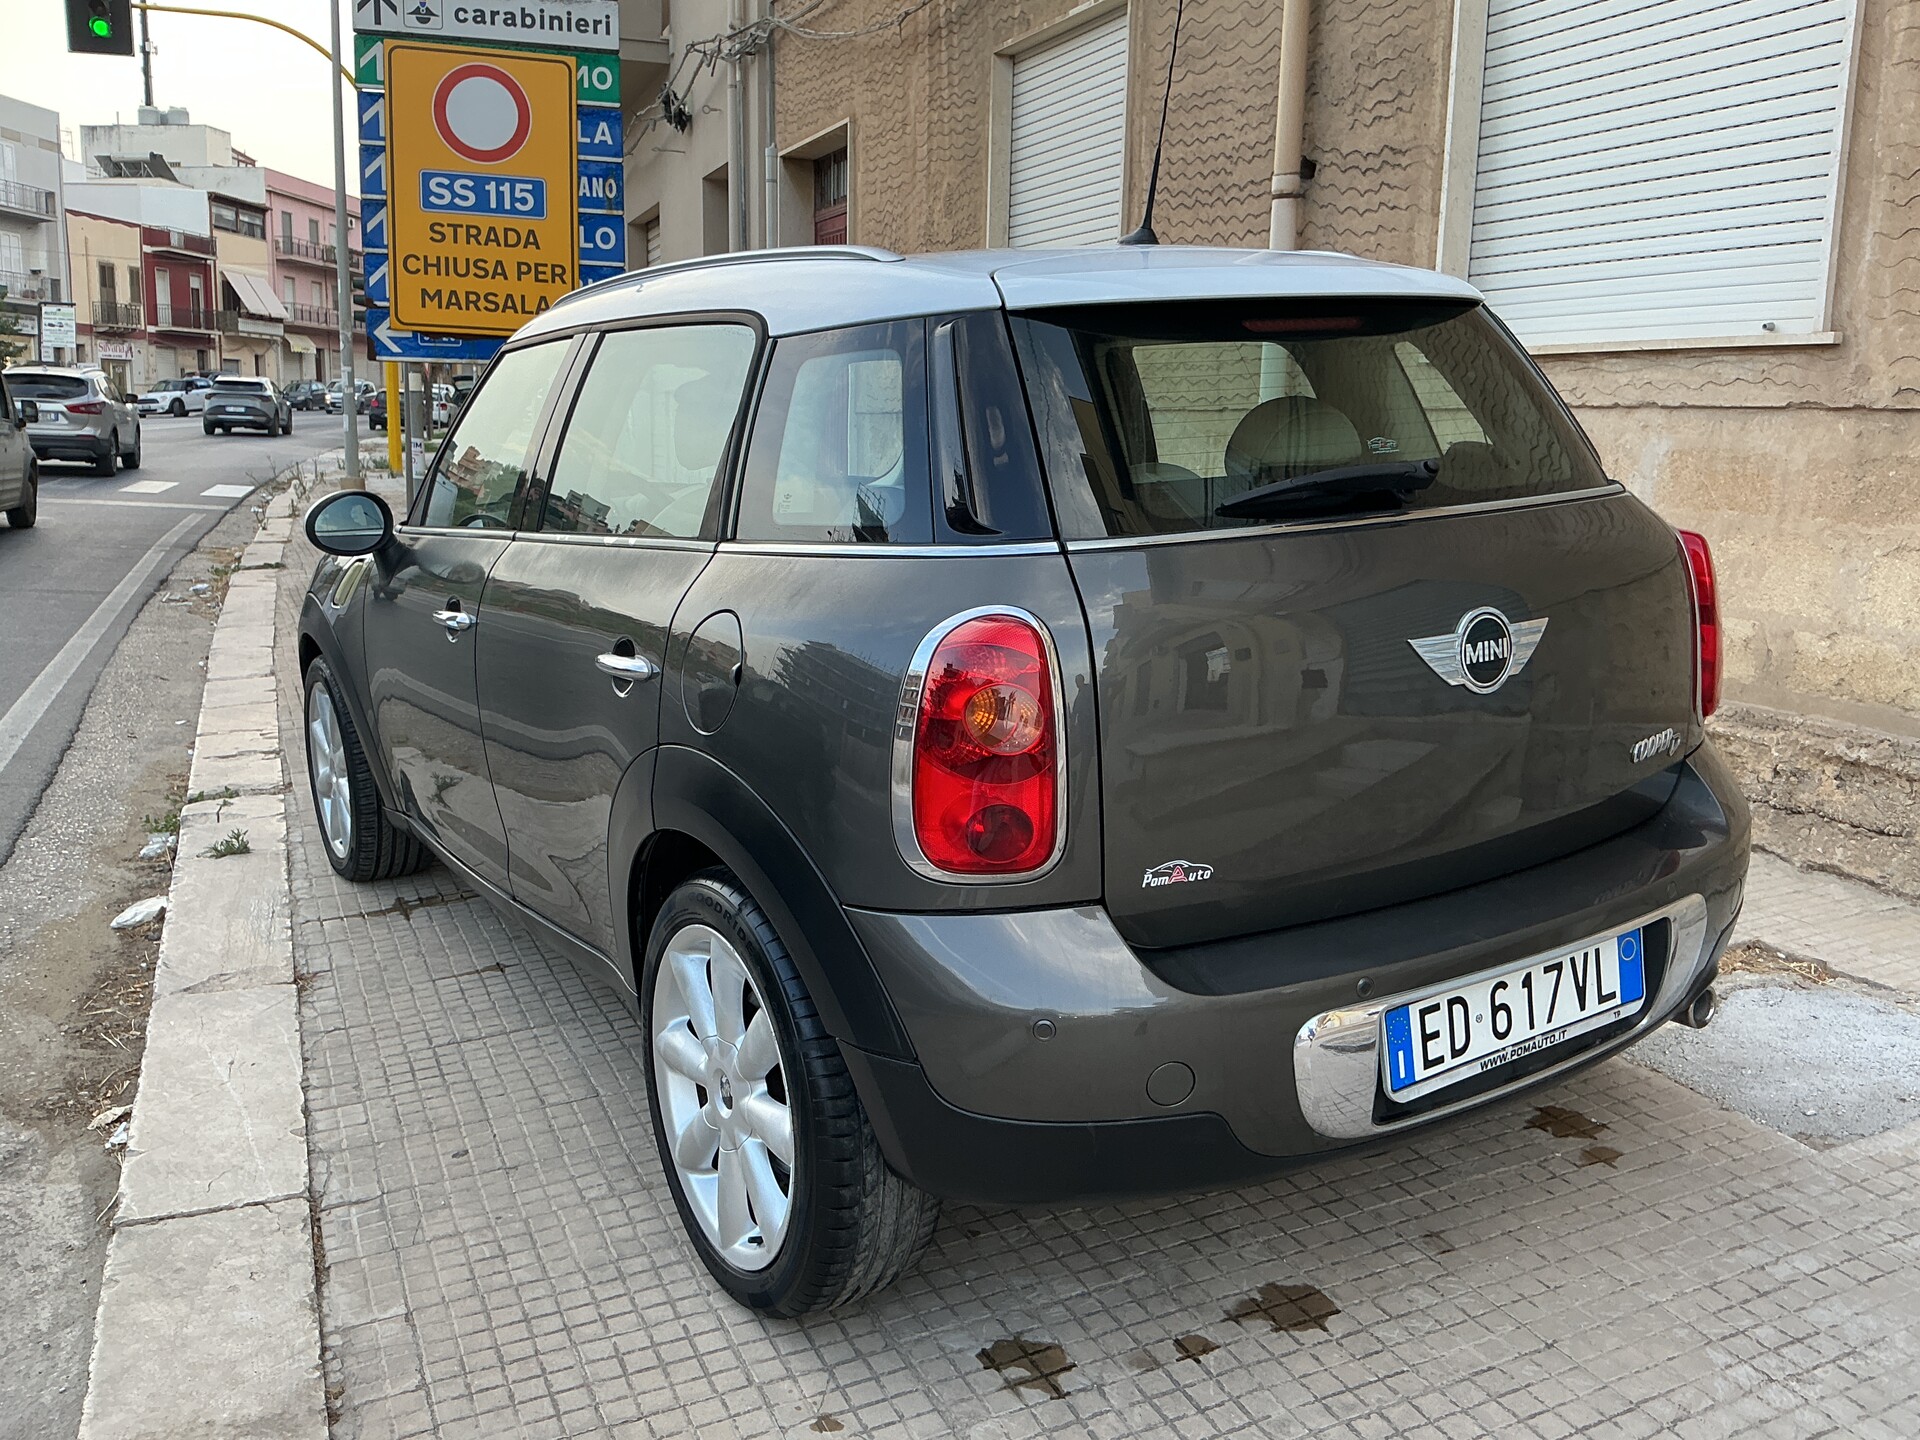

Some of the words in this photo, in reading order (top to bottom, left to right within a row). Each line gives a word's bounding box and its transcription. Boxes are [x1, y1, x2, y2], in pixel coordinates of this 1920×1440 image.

[454, 6, 611, 36] carabinieri
[428, 176, 476, 207] SS
[484, 180, 535, 212] 115
[428, 221, 541, 250] STRADA
[402, 253, 509, 281] CHIUSA
[516, 261, 568, 285] PER
[420, 287, 551, 316] MARSALA
[1465, 637, 1508, 665] MINI
[1632, 727, 1674, 763] COOPER
[1418, 995, 1471, 1072] ED
[1489, 946, 1617, 1041] 617VL
[1480, 1029, 1568, 1071] WWW.POMAUTO.IT
